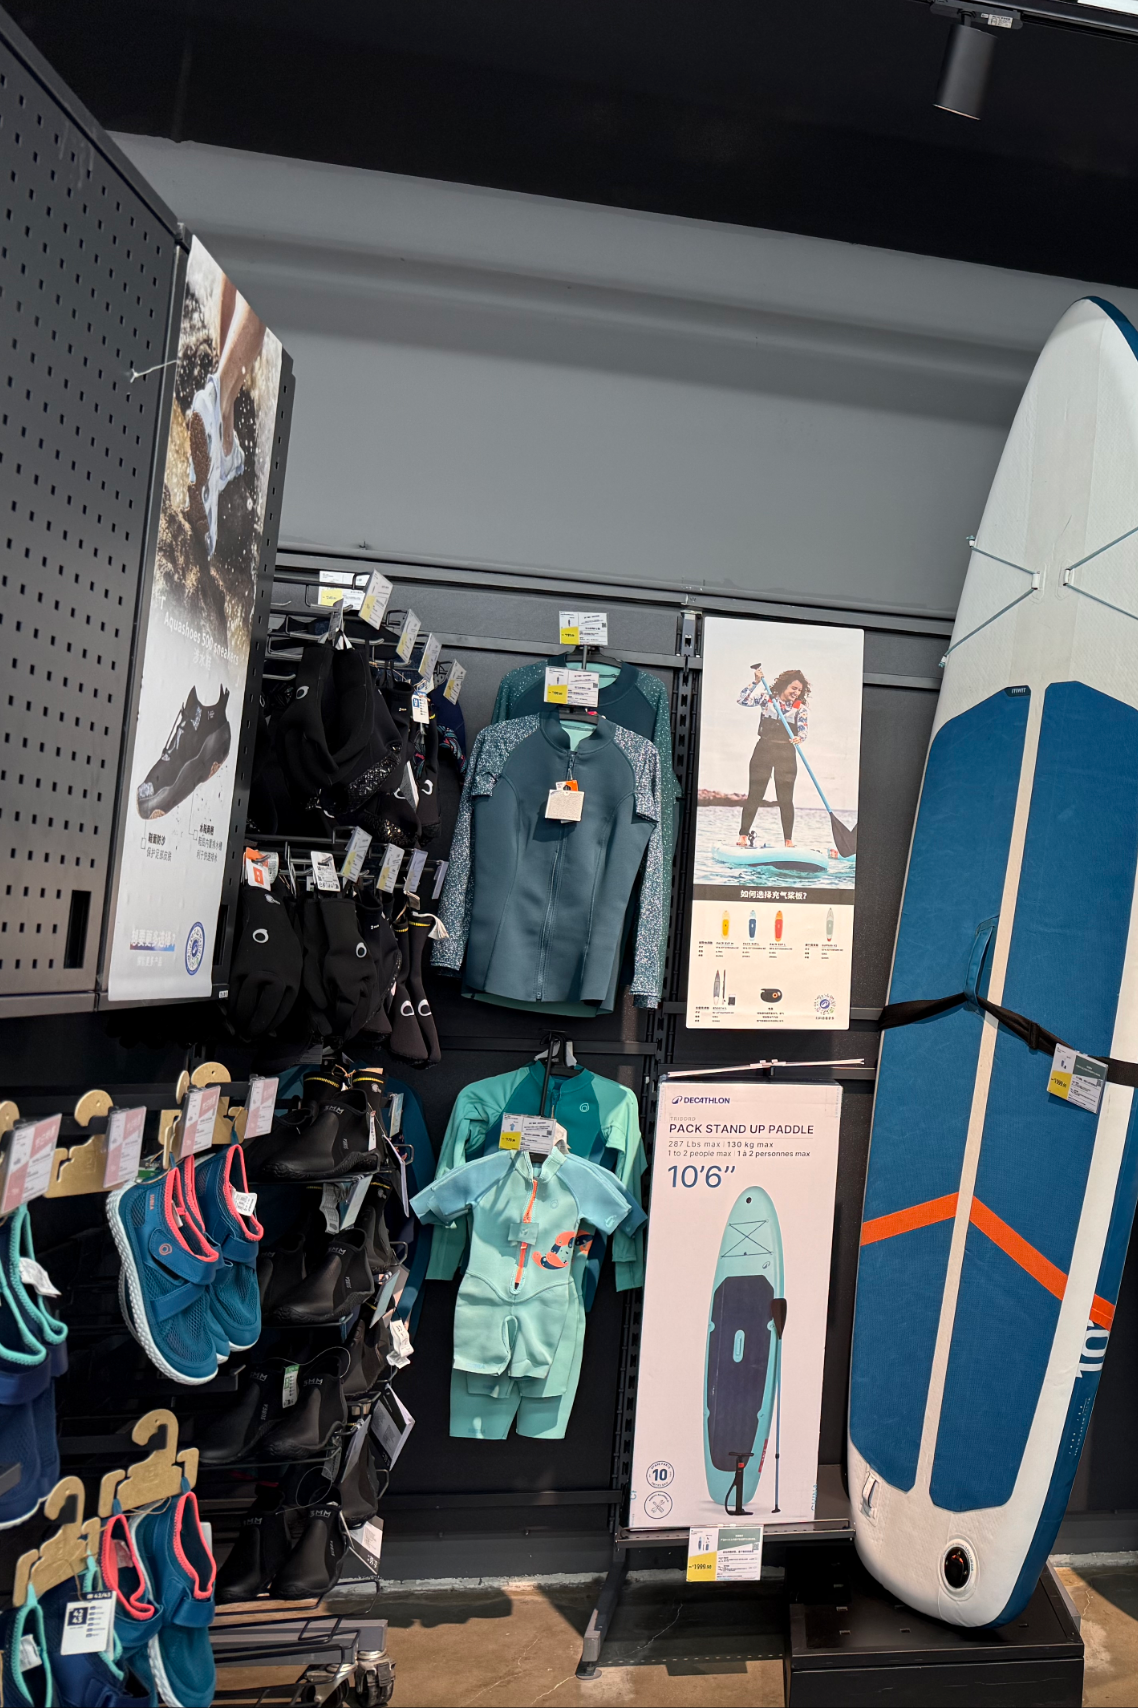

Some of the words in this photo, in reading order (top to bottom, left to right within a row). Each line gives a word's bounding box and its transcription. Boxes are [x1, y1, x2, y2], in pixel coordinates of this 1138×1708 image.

[163, 611, 201, 644] Aquashoes
[201, 632, 214, 650] 500
[213, 641, 239, 666] sneakers
[740, 889, 808, 900] 如何选择充气桨板?
[683, 1096, 730, 1104] DECATHLON
[669, 1123, 702, 1134] PACK
[705, 1123, 746, 1134] STAND
[749, 1124, 766, 1134] UP
[768, 1124, 814, 1135] PADDLE
[668, 1140, 684, 1148] 287
[686, 1140, 701, 1148] Lbs
[744, 1141, 755, 1149] kg
[756, 1141, 774, 1149] max
[755, 1151, 794, 1159] personnes
[653, 1468, 668, 1481] 10
